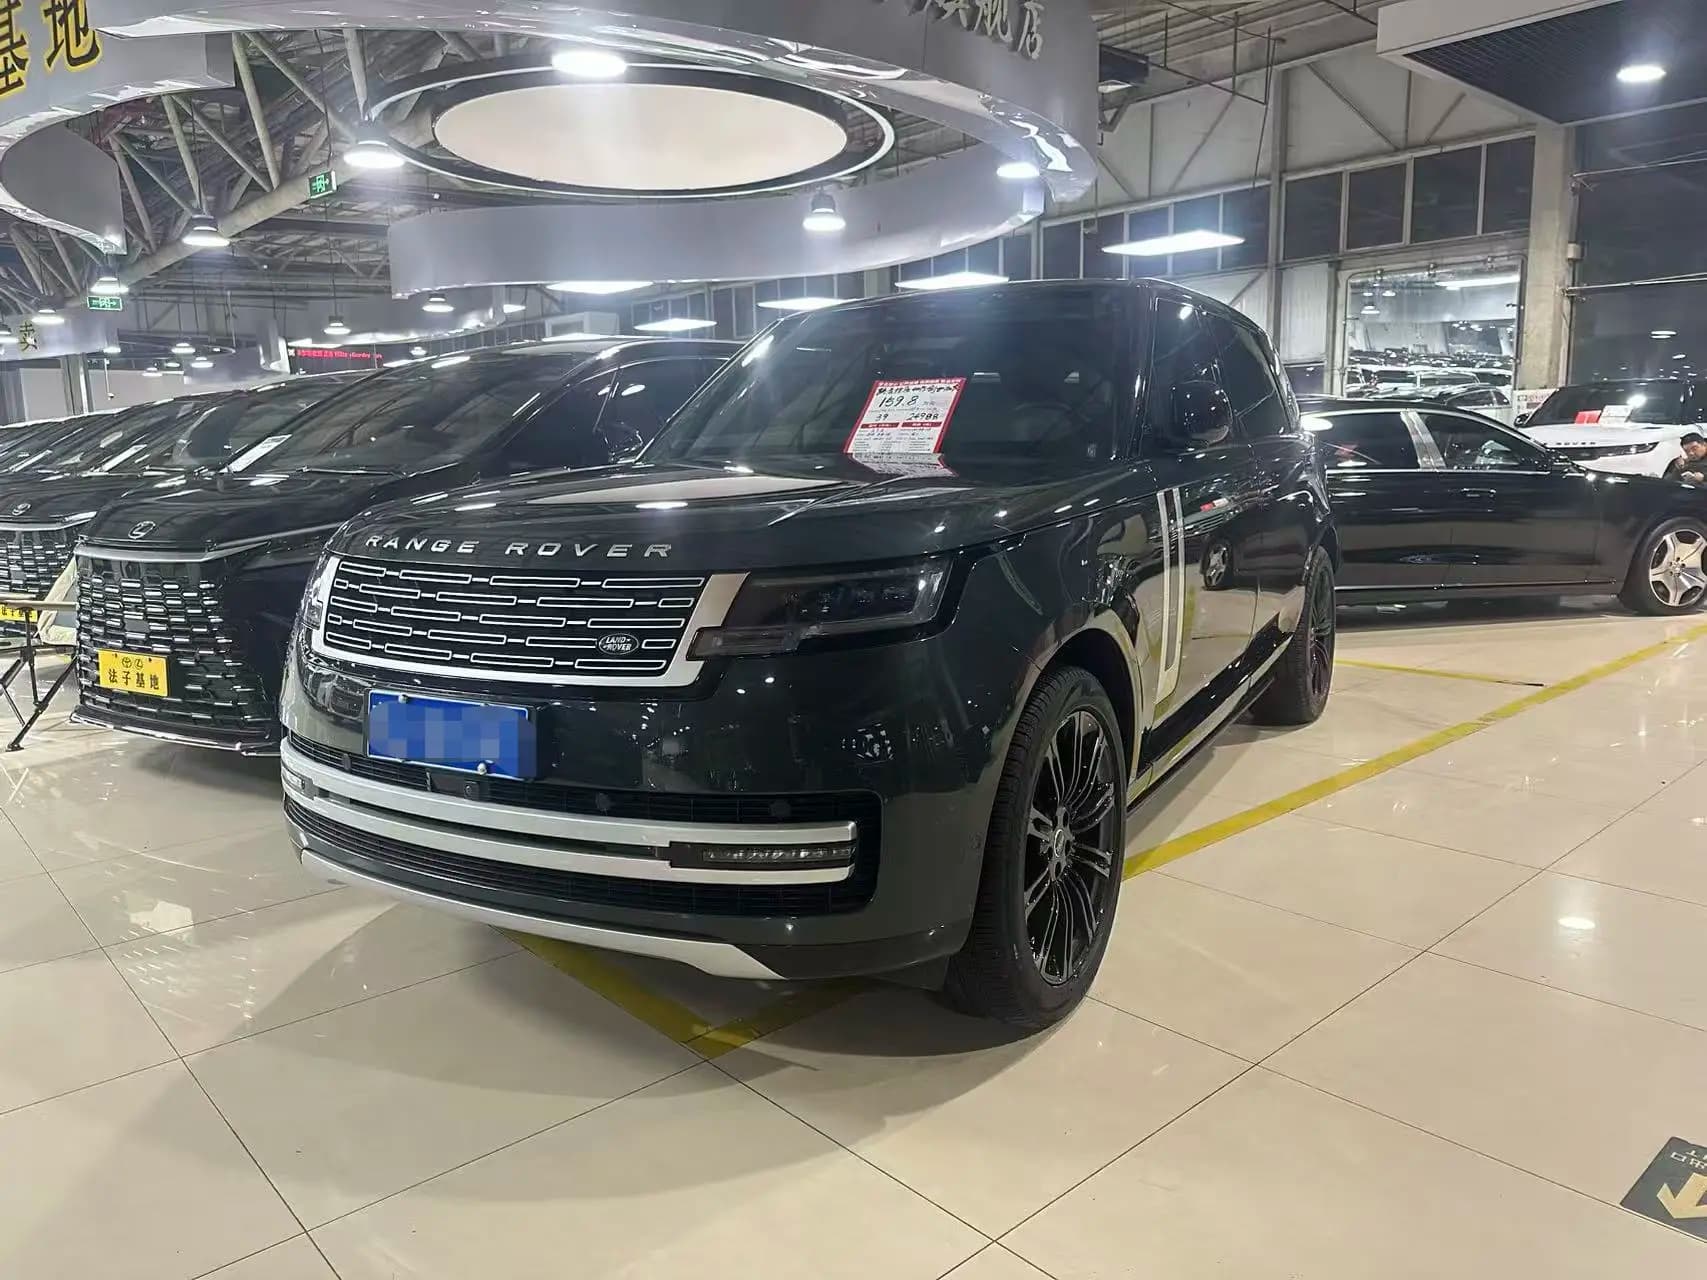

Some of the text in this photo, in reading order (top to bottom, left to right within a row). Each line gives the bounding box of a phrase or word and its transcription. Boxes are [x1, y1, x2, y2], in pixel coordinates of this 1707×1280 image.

[879, 395, 919, 408] 159.8
[365, 535, 673, 558] RANGE ROVER
[606, 636, 627, 644] LAND
[606, 643, 632, 651] ROVER
[108, 668, 160, 690] 法子基地
